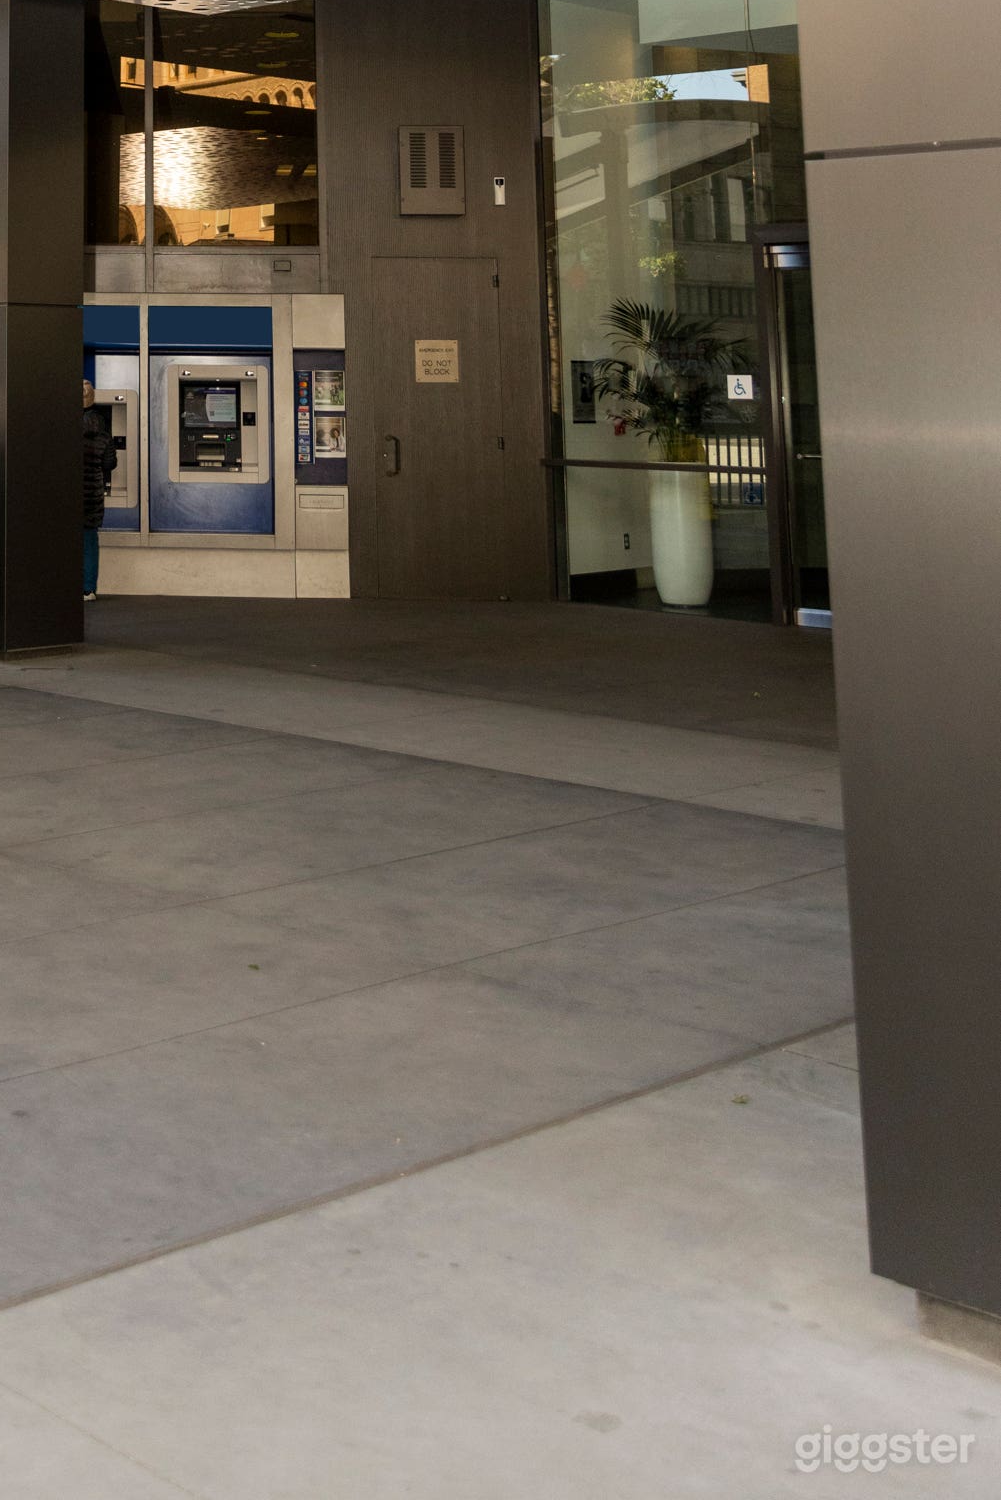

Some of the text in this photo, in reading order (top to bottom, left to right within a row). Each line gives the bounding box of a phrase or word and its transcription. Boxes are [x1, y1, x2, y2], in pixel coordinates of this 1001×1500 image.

[422, 359, 451, 367] DO NOT
[424, 368, 450, 376] BLOCK
